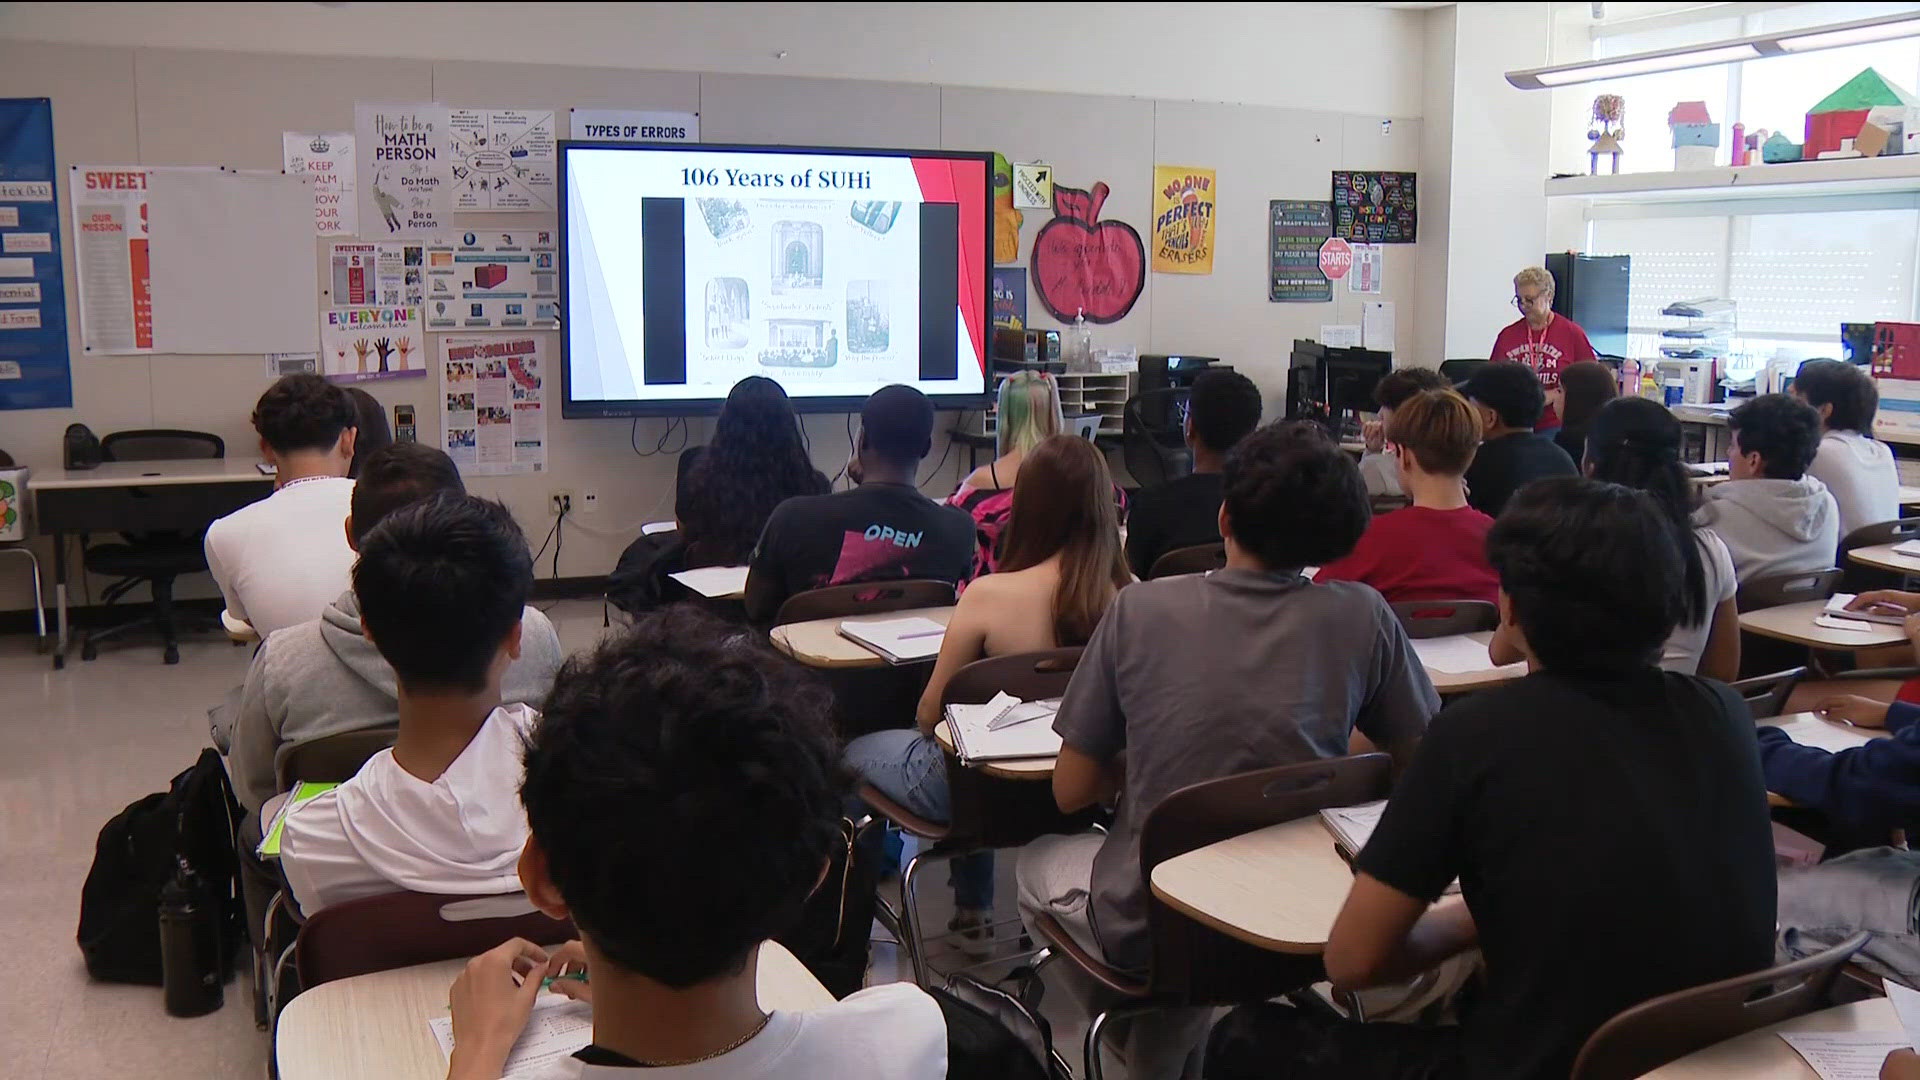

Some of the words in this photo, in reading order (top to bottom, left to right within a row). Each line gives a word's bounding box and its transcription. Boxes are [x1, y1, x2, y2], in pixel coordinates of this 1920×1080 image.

[376, 114, 398, 137] How
[400, 115, 408, 131] to
[412, 114, 422, 131] be
[585, 124, 620, 137] TYPES
[623, 125, 638, 138] OF
[641, 126, 686, 139] ERRORS
[384, 133, 427, 146] MATH
[376, 147, 436, 160] PERSON
[308, 161, 334, 171] KEEP
[314, 175, 337, 184] ALM
[401, 177, 414, 186] Do
[416, 177, 440, 186] Math
[681, 167, 719, 187] 106
[724, 168, 784, 188] Years
[790, 168, 813, 188] of
[818, 170, 872, 189] SUHi
[1163, 179, 1181, 200] NO
[1185, 175, 1210, 192] ONE
[315, 195, 340, 204] OW
[315, 208, 339, 217] OUR
[413, 211, 424, 219] Be
[1156, 201, 1213, 233] PERFECT
[81, 223, 123, 232] MISSION
[316, 221, 341, 230] ORK
[408, 219, 438, 228] Person
[1158, 246, 1208, 264] ERASERS
[1321, 251, 1351, 266] STARTS
[328, 308, 416, 325] EVERYONE
[348, 322, 387, 331] welcome
[388, 319, 408, 329] here
[1536, 372, 1558, 384] VILS
[863, 524, 924, 549] OPEN
